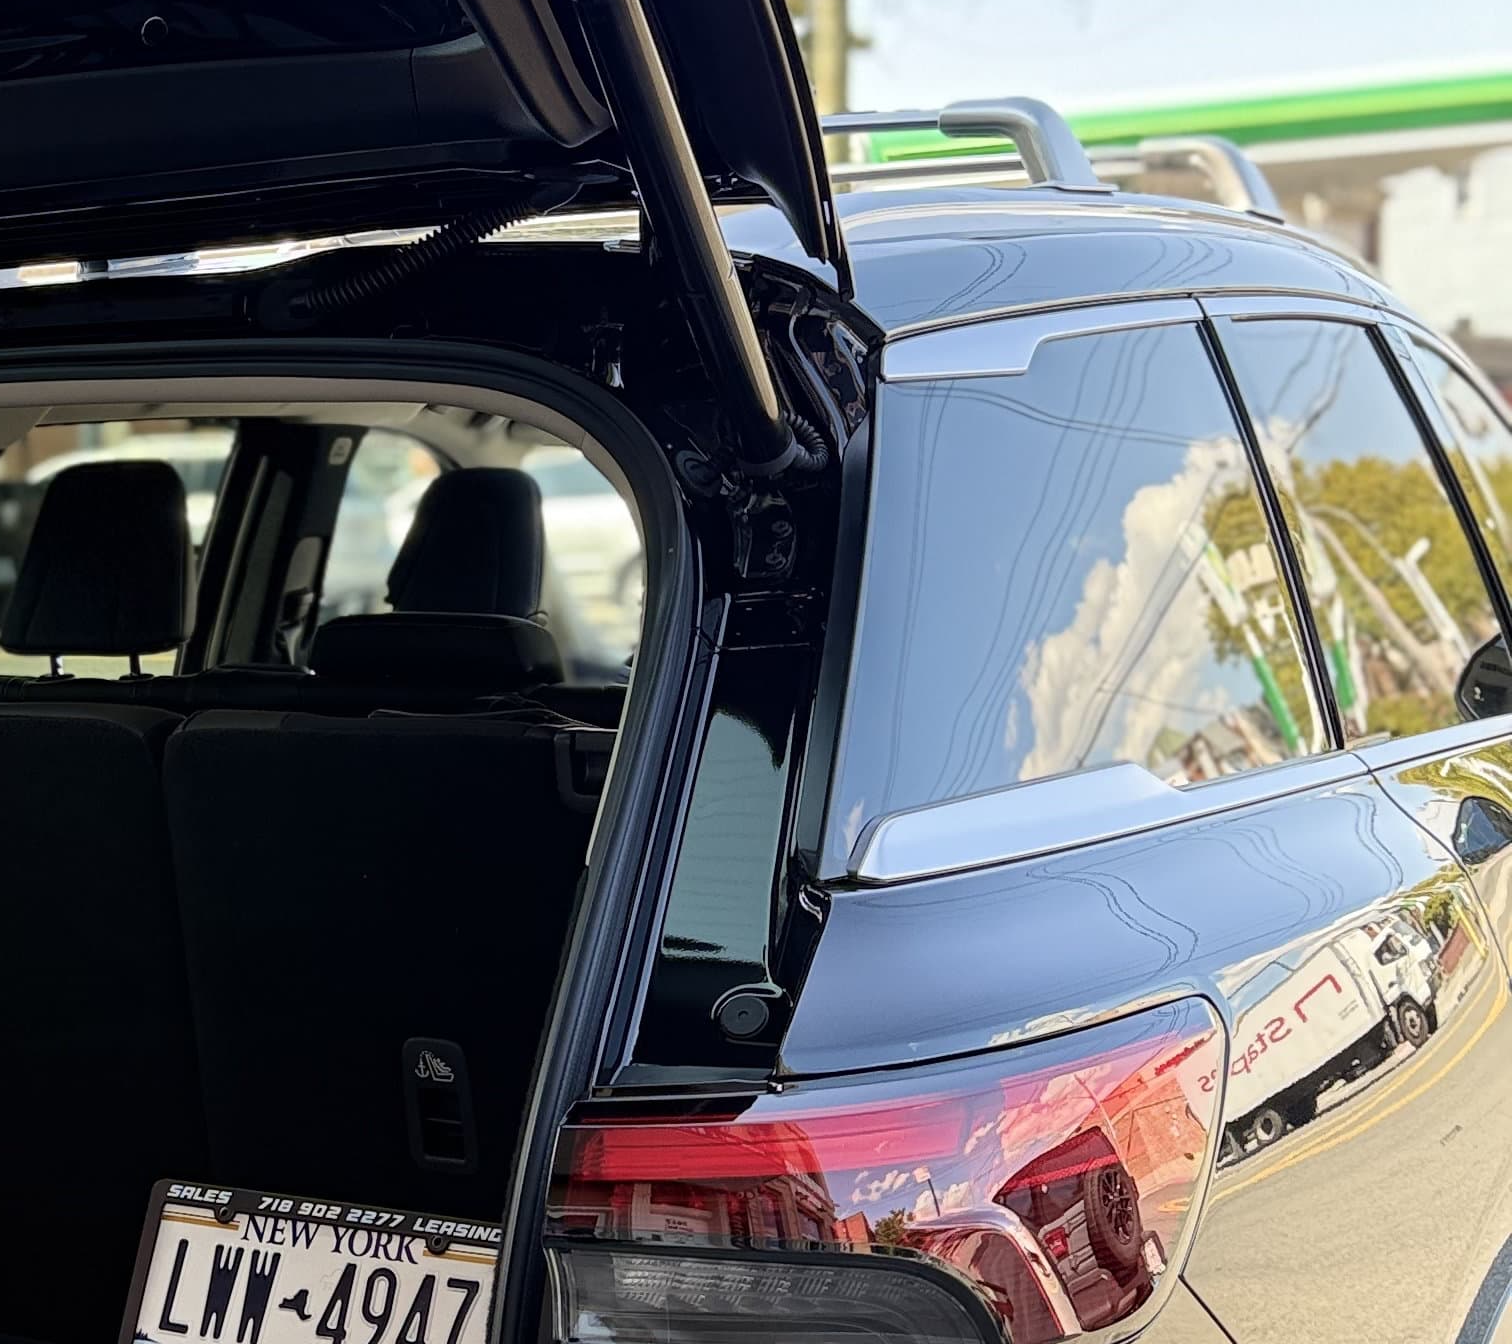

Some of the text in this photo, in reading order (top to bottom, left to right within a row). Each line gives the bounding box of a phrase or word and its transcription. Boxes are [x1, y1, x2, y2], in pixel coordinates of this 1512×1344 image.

[167, 1184, 503, 1243] SALES 718 902 2277 LEASING
[242, 1215, 418, 1265] NEW YORK
